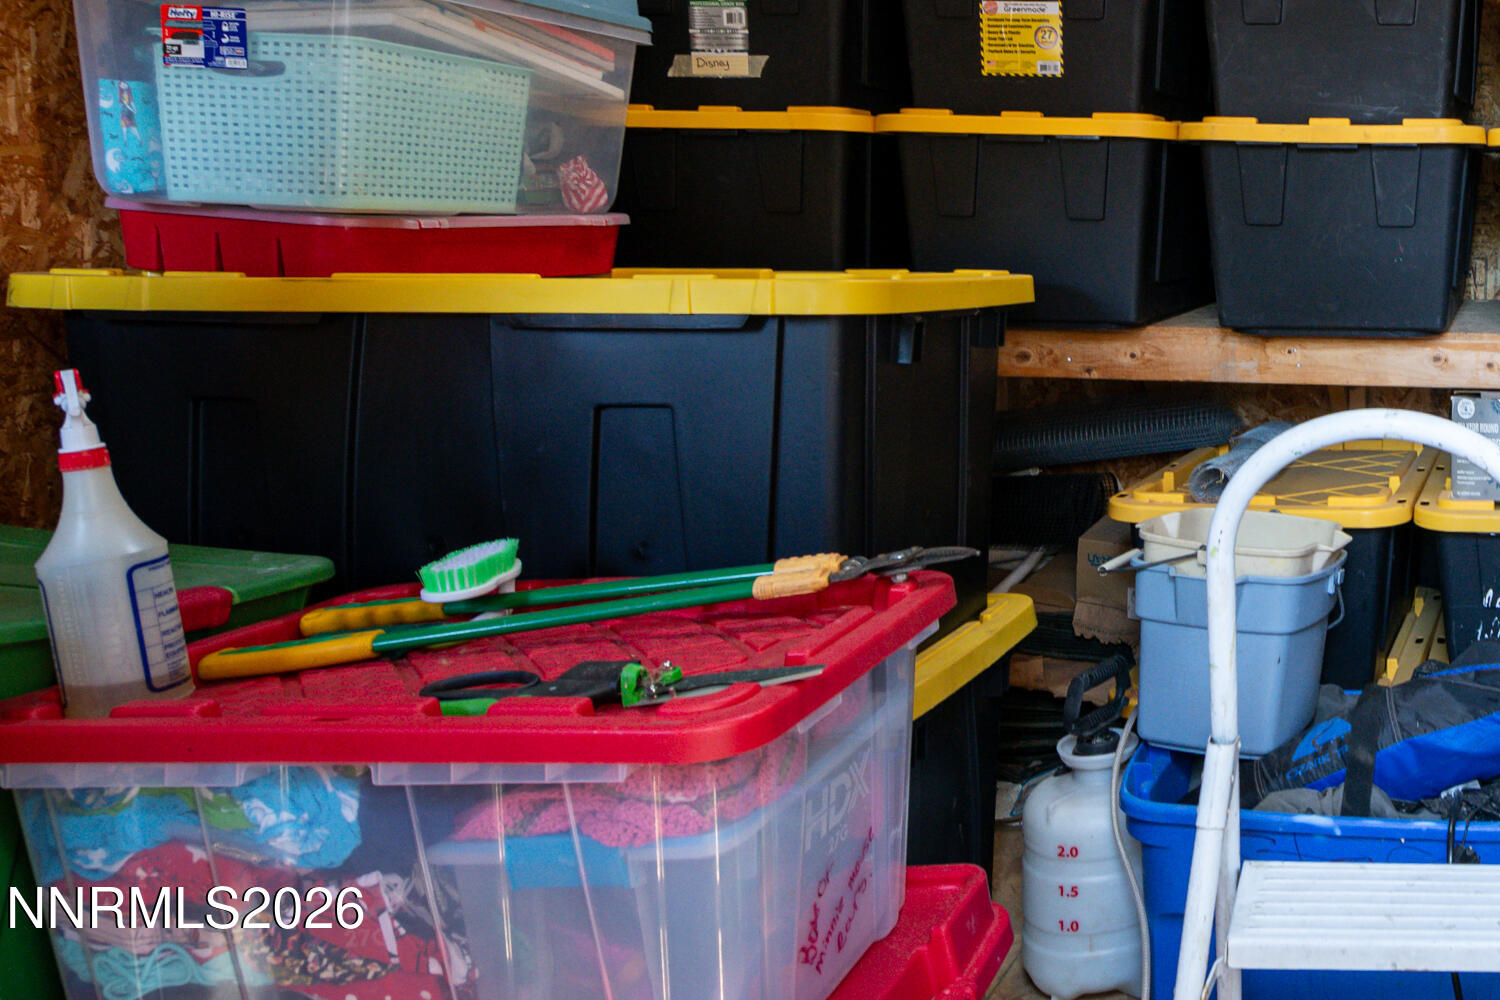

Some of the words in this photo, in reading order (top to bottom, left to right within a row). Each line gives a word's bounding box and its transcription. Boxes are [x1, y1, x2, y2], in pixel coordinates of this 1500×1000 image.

[168, 8, 197, 19] Hefty
[1041, 29, 1053, 40] 27
[696, 57, 731, 71] Disney
[1286, 752, 1331, 780] OZARK
[802, 748, 871, 853] HDX
[1057, 845, 1079, 858] 2.0
[1058, 885, 1079, 898] 1.5
[1058, 920, 1080, 933] 1.0
